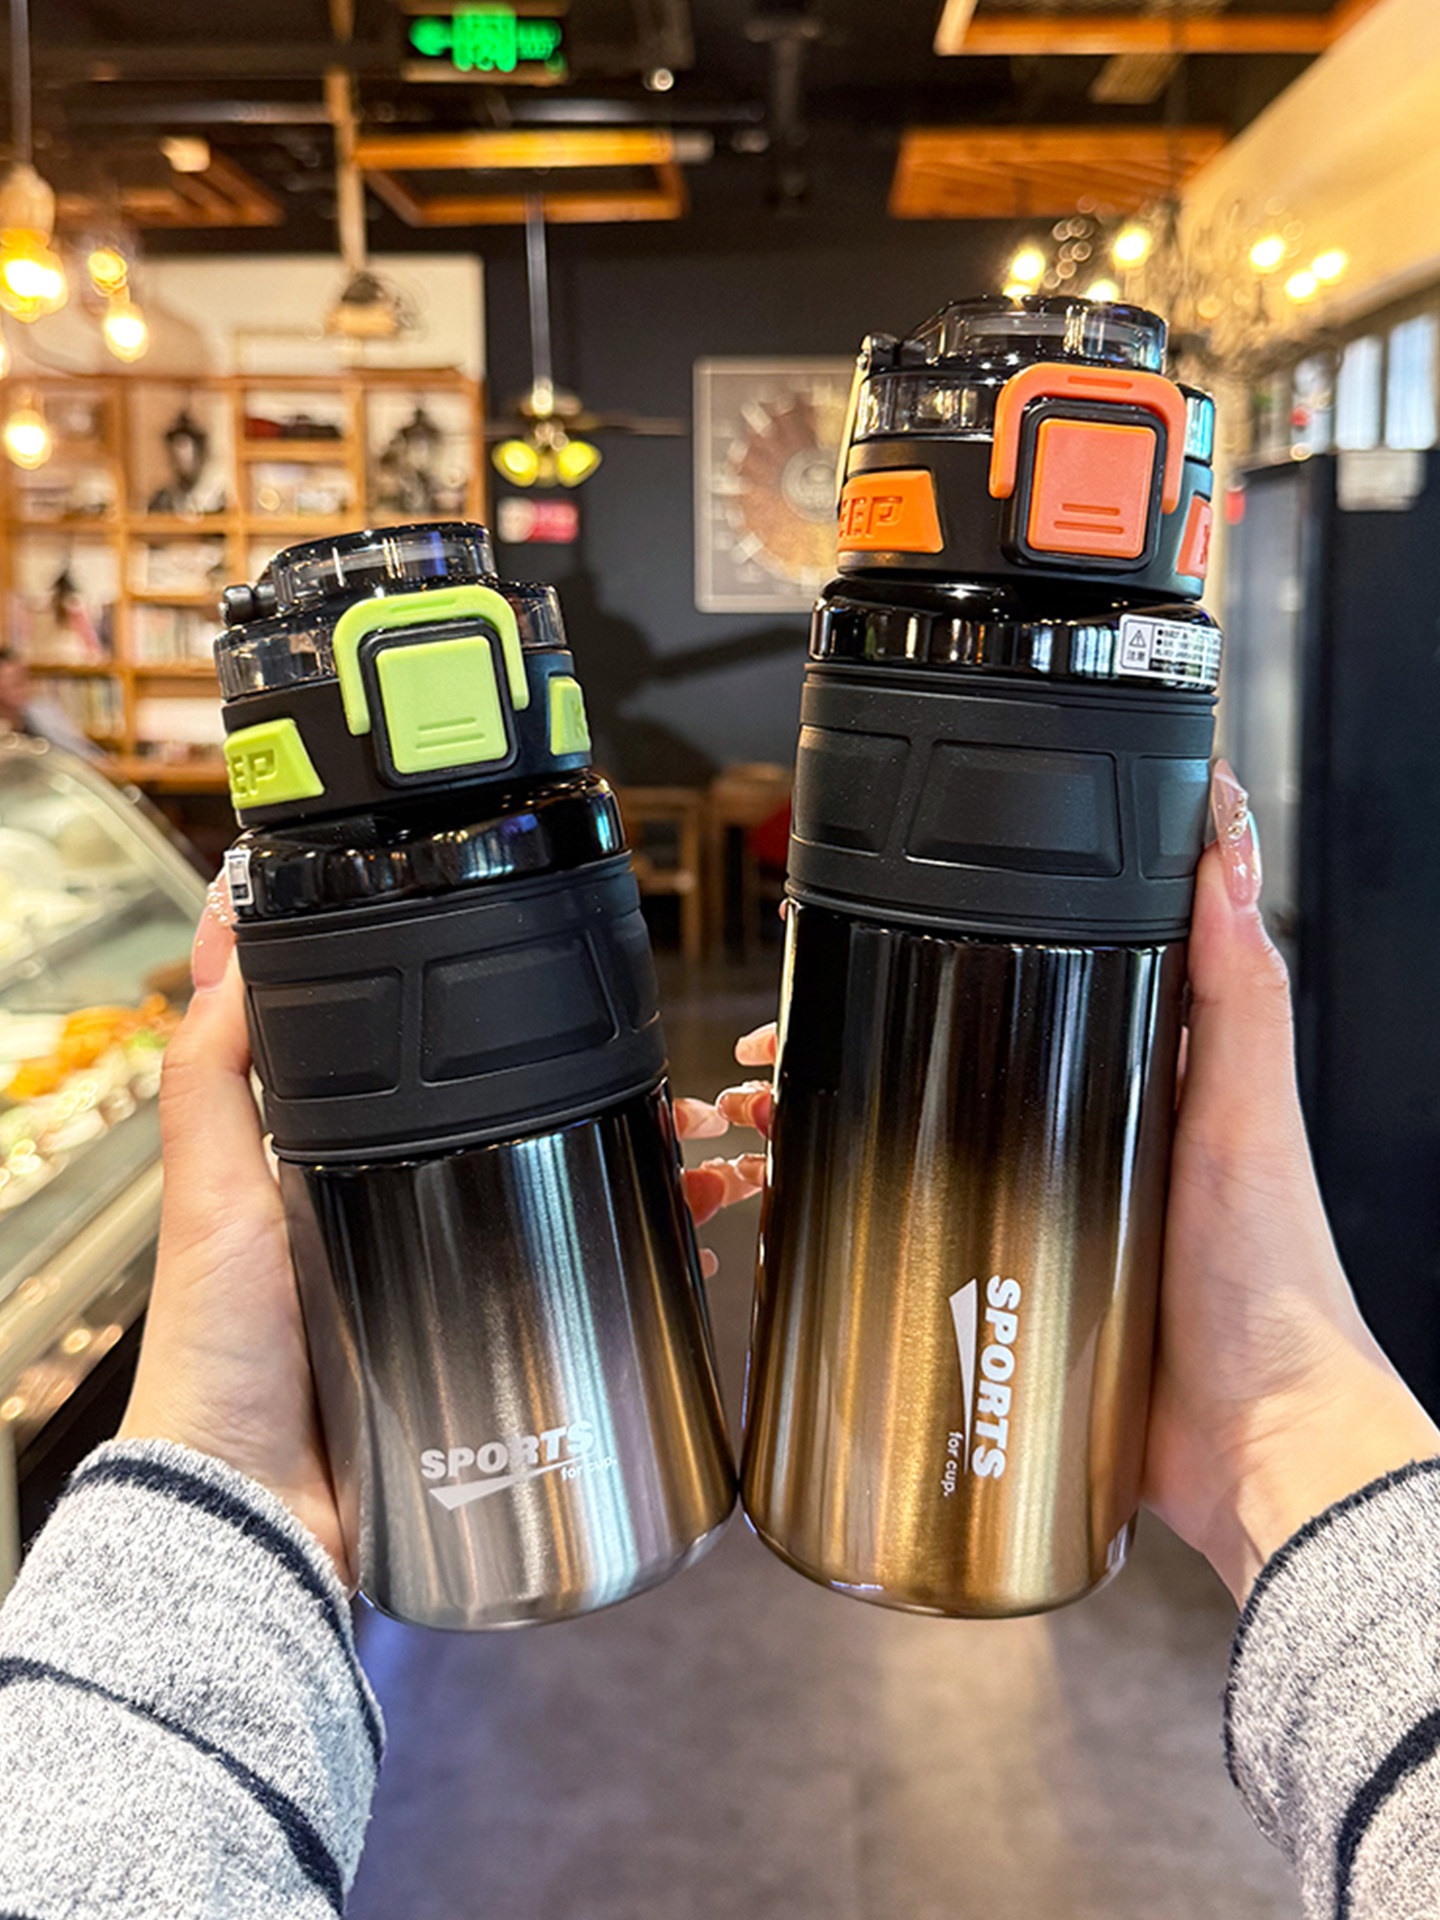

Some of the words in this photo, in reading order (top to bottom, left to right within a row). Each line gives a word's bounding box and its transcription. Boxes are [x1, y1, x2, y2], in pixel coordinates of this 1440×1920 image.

[972, 1275, 1021, 1479] SPORTS
[420, 1420, 594, 1479] SPORTS
[948, 1431, 963, 1457] for
[561, 1464, 583, 1481] for
[941, 1459, 957, 1496] cup.
